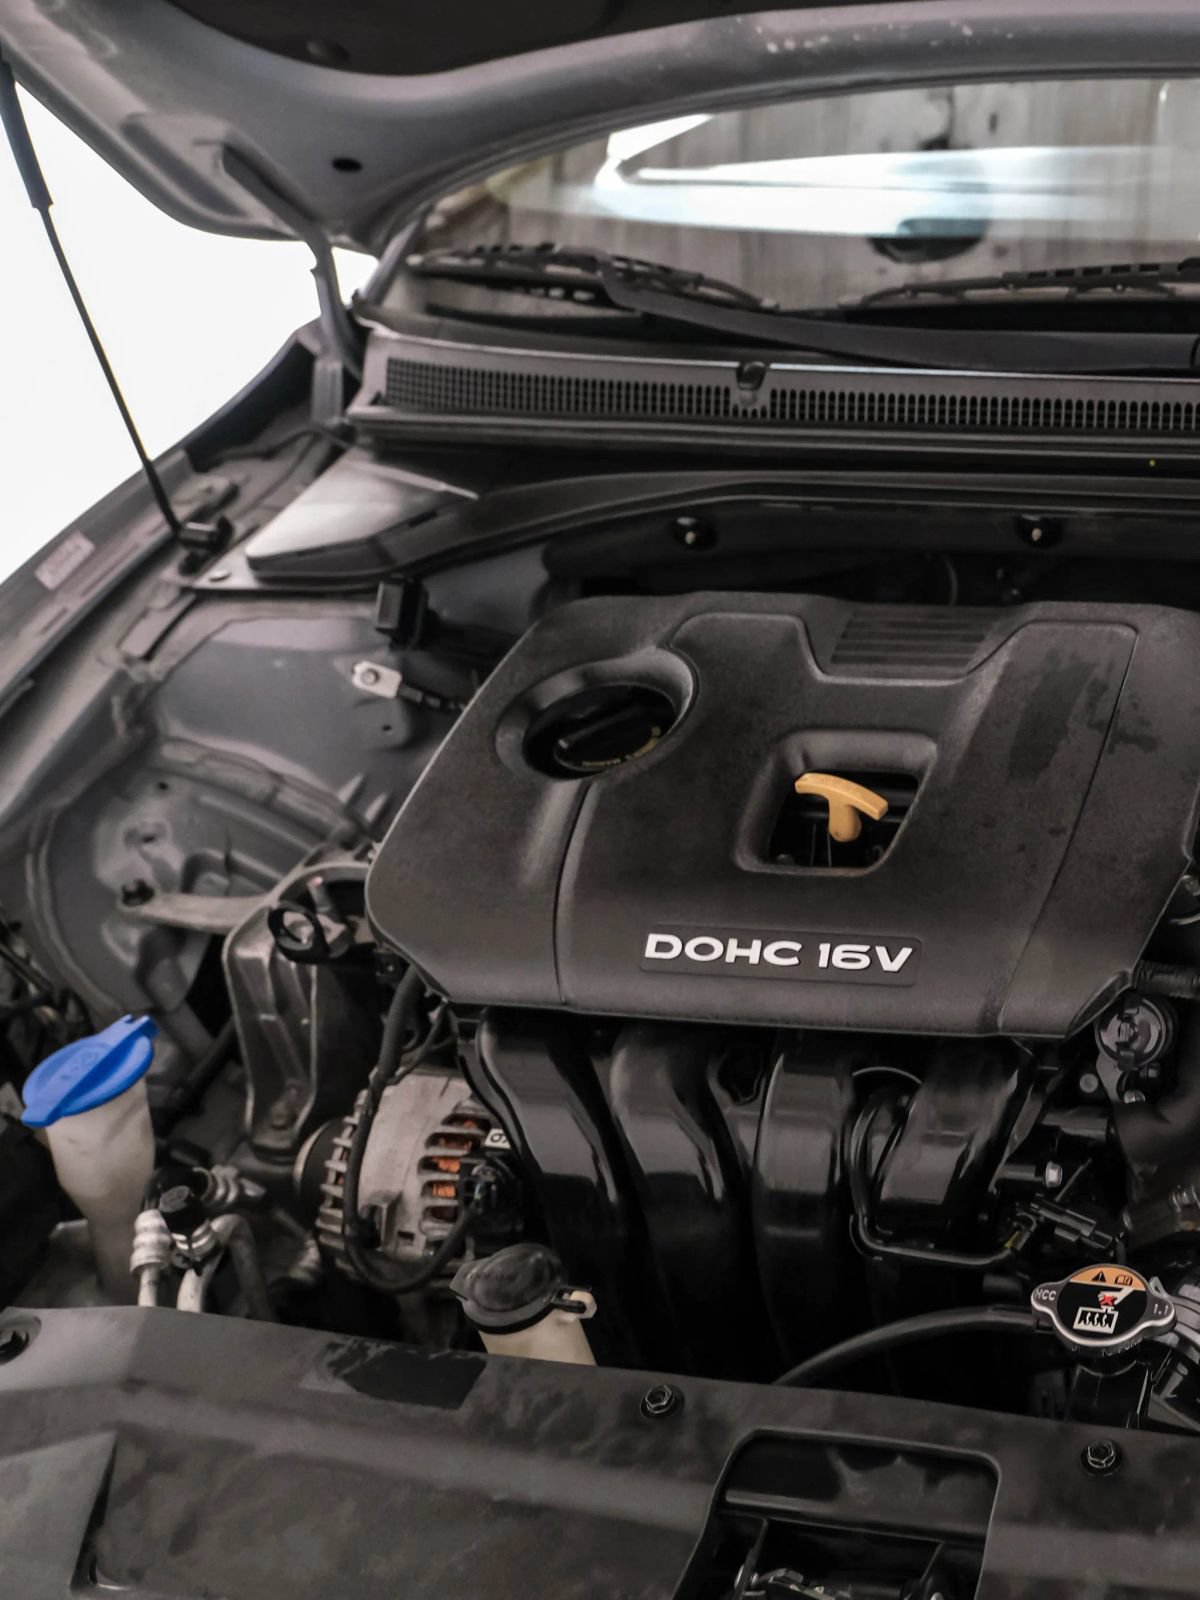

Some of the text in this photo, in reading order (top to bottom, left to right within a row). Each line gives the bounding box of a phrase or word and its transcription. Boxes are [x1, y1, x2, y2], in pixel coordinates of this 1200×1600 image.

[645, 933, 913, 972] DOHC 16V
[1153, 1303, 1169, 1315] 1.1
